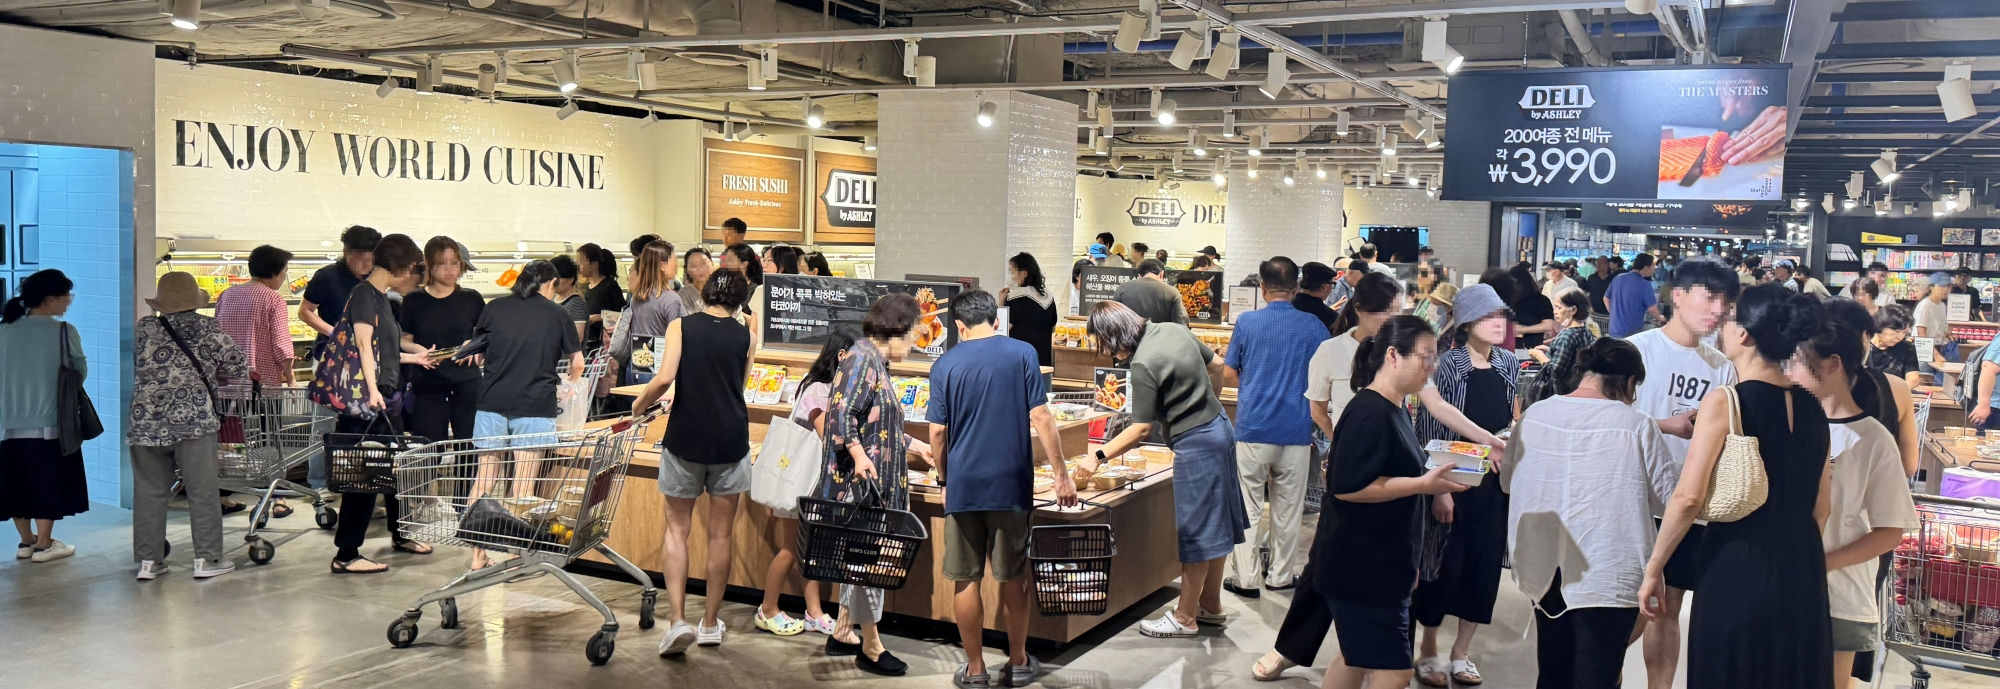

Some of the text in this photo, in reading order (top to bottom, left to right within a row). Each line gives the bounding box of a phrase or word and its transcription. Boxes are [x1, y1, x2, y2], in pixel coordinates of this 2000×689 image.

[1530, 87, 1585, 106] DELI
[1679, 85, 1769, 97] THE MASTERS
[1531, 110, 1582, 119] by ASHLEY
[1504, 127, 1613, 144] 200여종 전 메뉴
[172, 119, 606, 191] ENJOY WORLD CUISINE
[1496, 149, 1508, 160] 각
[722, 174, 789, 194] FRESH SUSHI
[728, 198, 744, 207] Ashley
[1138, 201, 1175, 216] DELI
[839, 209, 873, 222] by ASHLEY
[1100, 275, 1117, 283] 오징어
[771, 287, 794, 299] 문어가
[770, 300, 801, 312] 타코야끼
[1668, 373, 1711, 401] 1987
